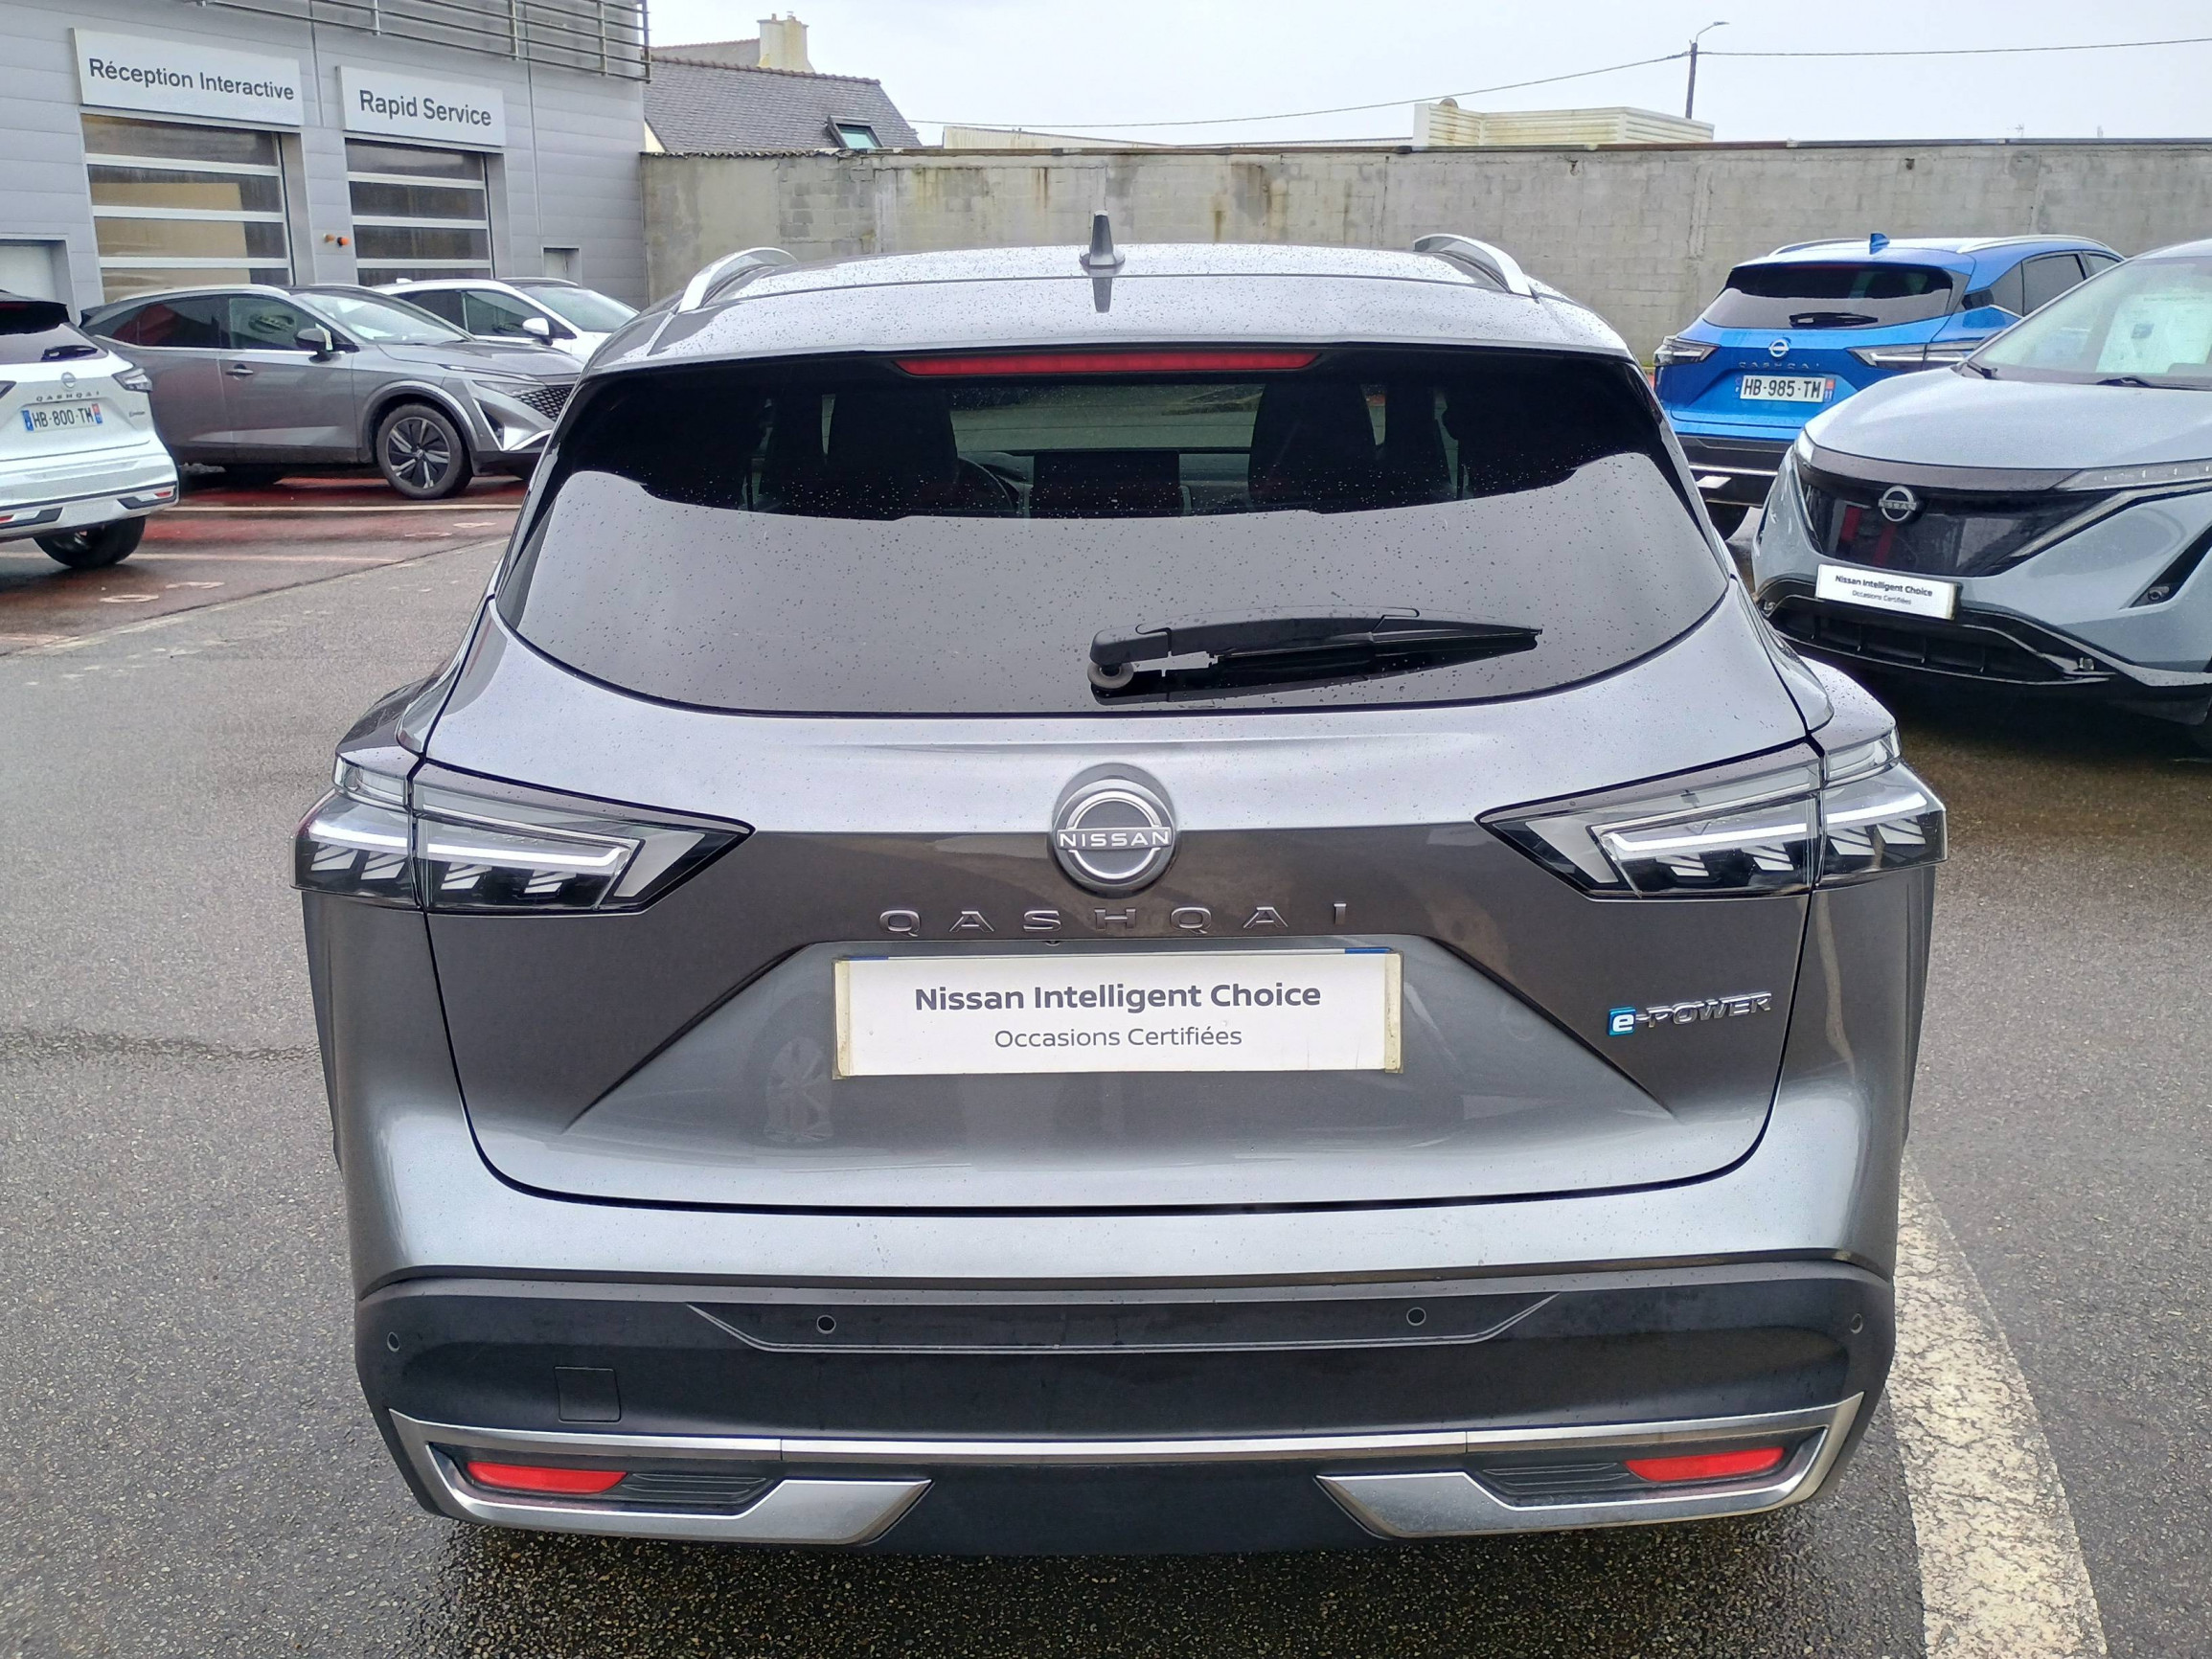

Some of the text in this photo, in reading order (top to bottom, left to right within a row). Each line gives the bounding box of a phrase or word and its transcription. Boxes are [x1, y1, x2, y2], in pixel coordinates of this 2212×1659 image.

[89, 57, 294, 101] Réception Interactive
[359, 89, 491, 126] Rapid Service
[1835, 575, 1933, 597] Nissan Intelligent Choice
[1059, 828, 1172, 848] NISSAN
[878, 902, 1348, 938] QASHQAI
[915, 982, 1321, 1013] Nissan Intelligent Choice
[994, 1025, 1243, 1048] Occasions Certifiées
